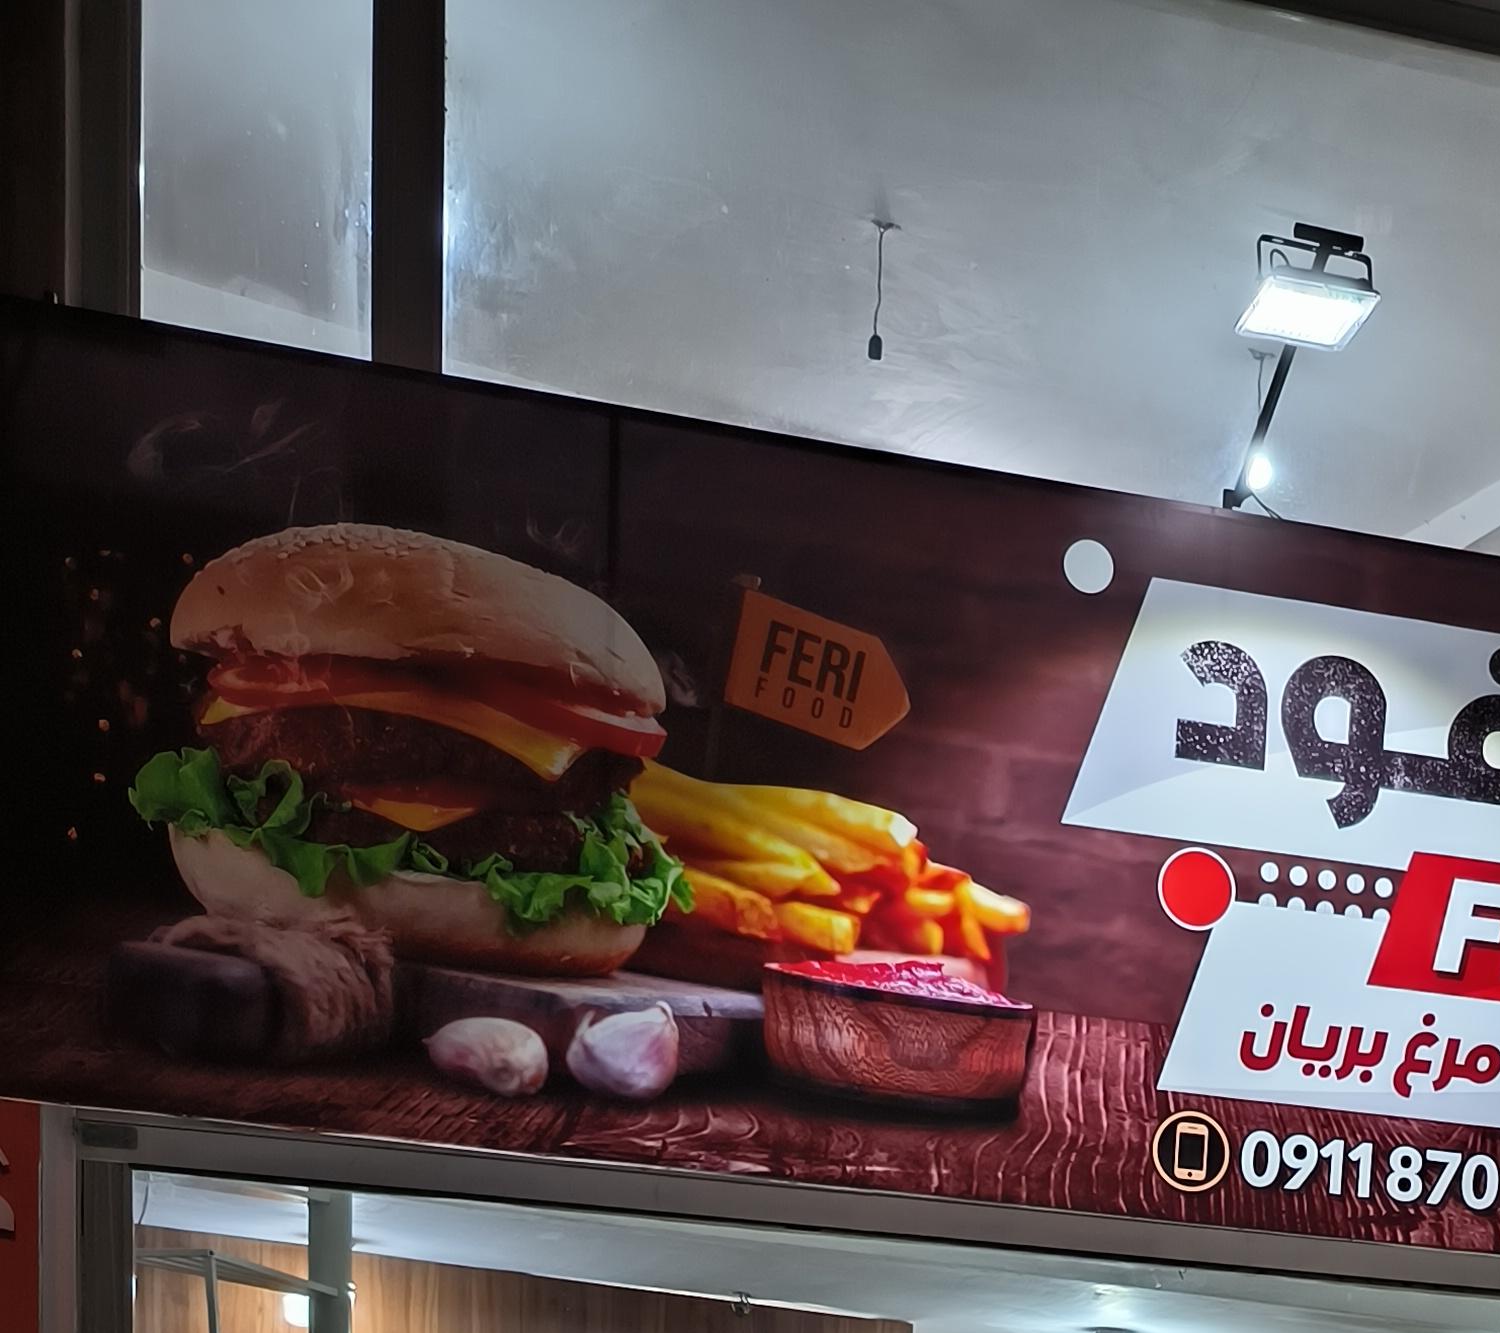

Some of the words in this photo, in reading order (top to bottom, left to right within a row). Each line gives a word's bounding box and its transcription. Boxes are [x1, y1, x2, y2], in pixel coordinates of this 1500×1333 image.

[760, 620, 866, 704] FERI
[755, 676, 853, 729] FOOD
[1240, 1003, 1389, 1083] بریان
